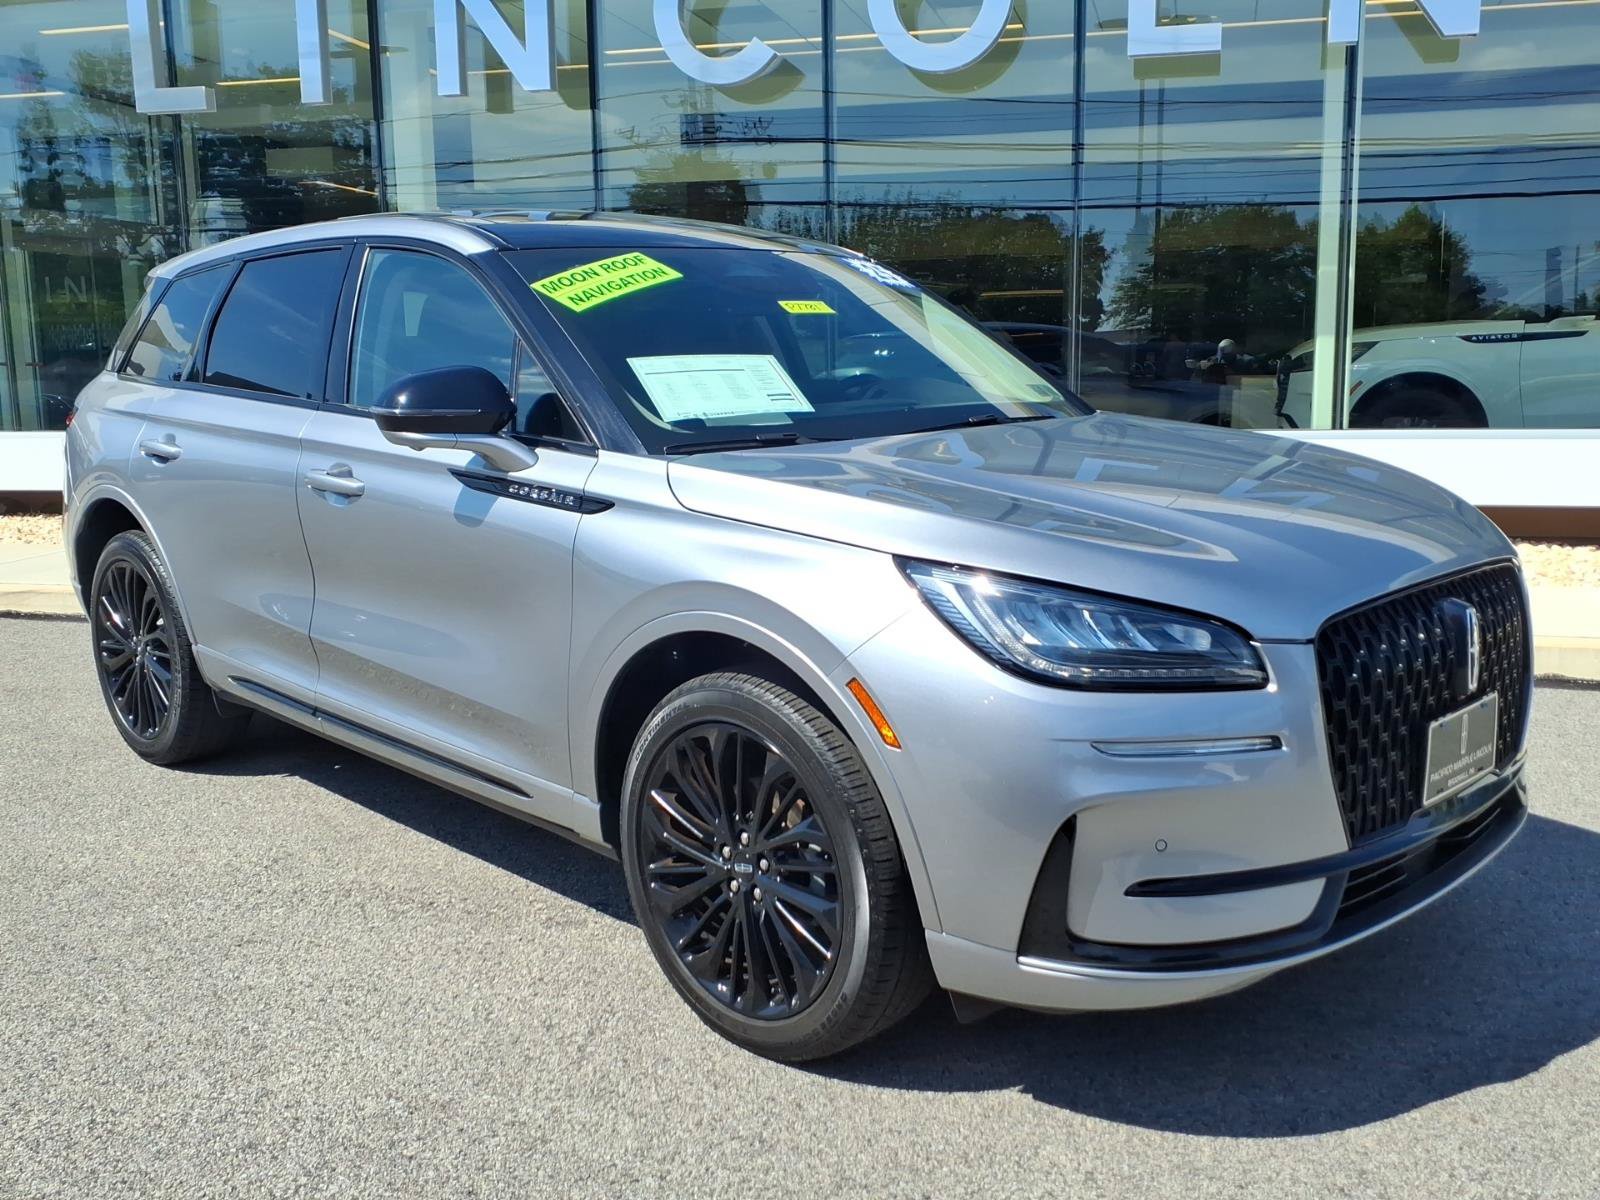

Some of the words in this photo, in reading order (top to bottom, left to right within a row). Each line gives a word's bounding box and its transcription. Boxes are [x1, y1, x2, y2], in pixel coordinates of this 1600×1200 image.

[131, 0, 1481, 113] LINCO
[541, 268, 599, 294] MOON
[599, 255, 646, 273] ROOF
[568, 267, 668, 305] NAVIGATION
[1471, 333, 1518, 341] AVIATOR
[508, 484, 574, 506] CORSAIR
